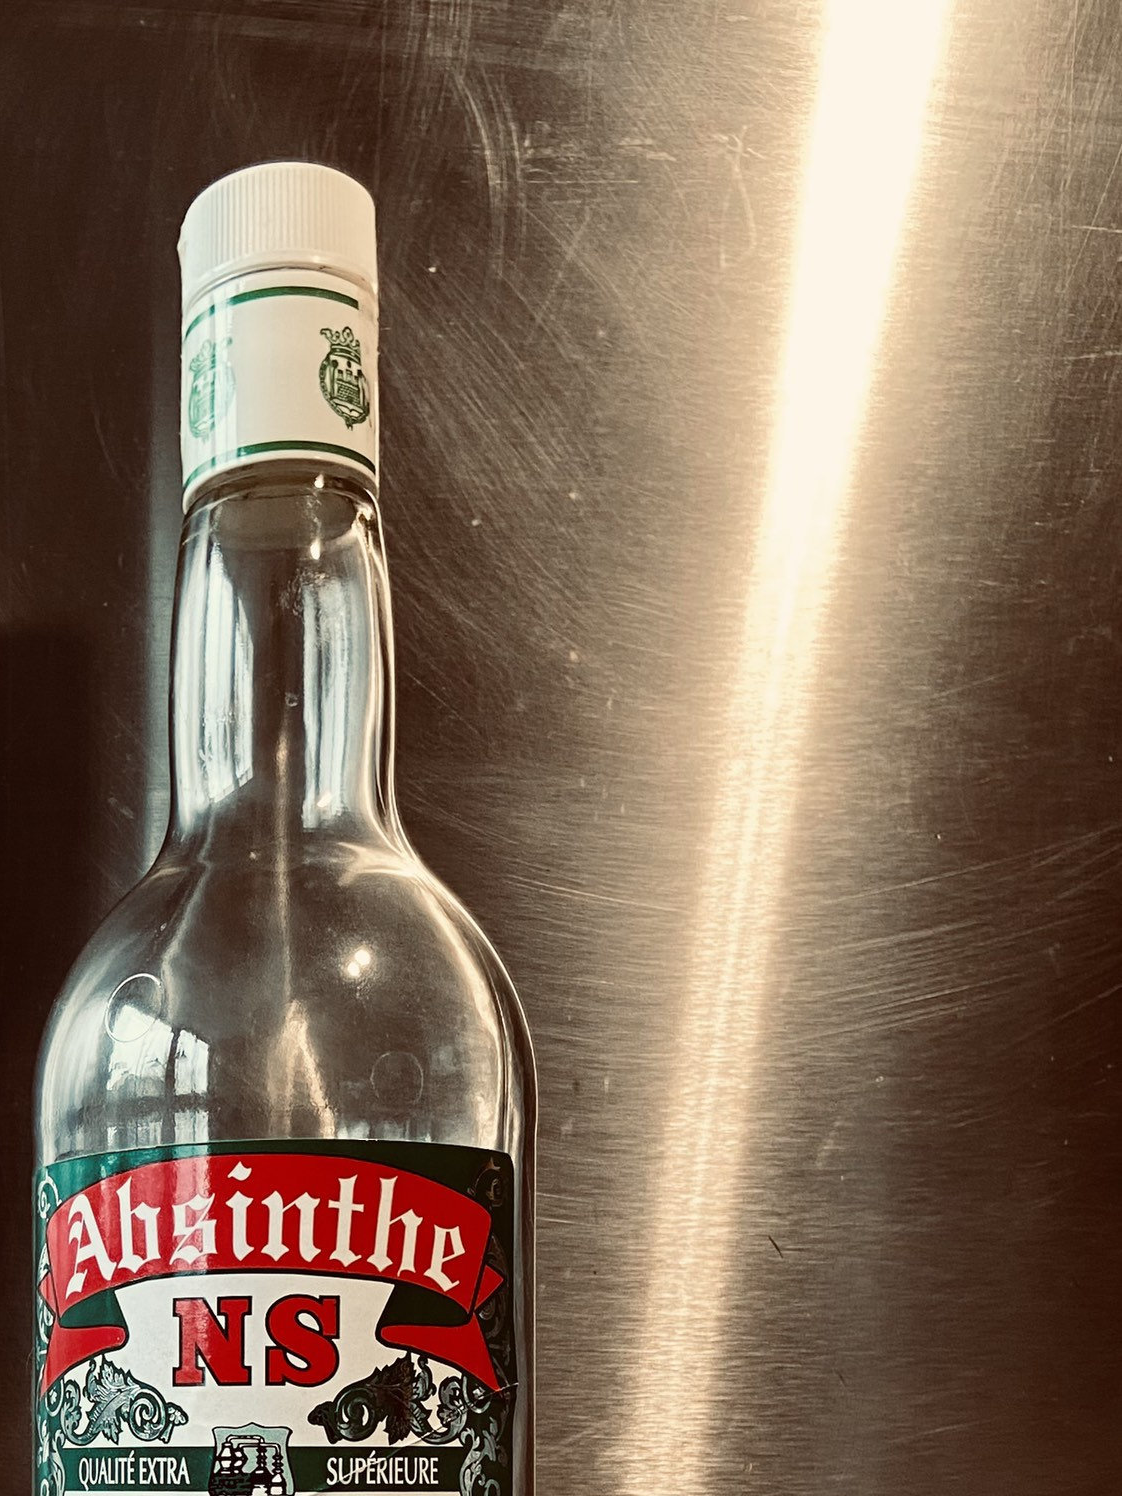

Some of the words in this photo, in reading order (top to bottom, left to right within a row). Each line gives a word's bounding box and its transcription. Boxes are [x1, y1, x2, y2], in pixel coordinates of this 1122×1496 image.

[65, 1161, 466, 1298] Absinthe
[172, 1294, 340, 1387] NS
[78, 1450, 134, 1490] QUALITÉ
[139, 1457, 190, 1486] EXTRA
[326, 1450, 439, 1486] SUPÉRIEURE
